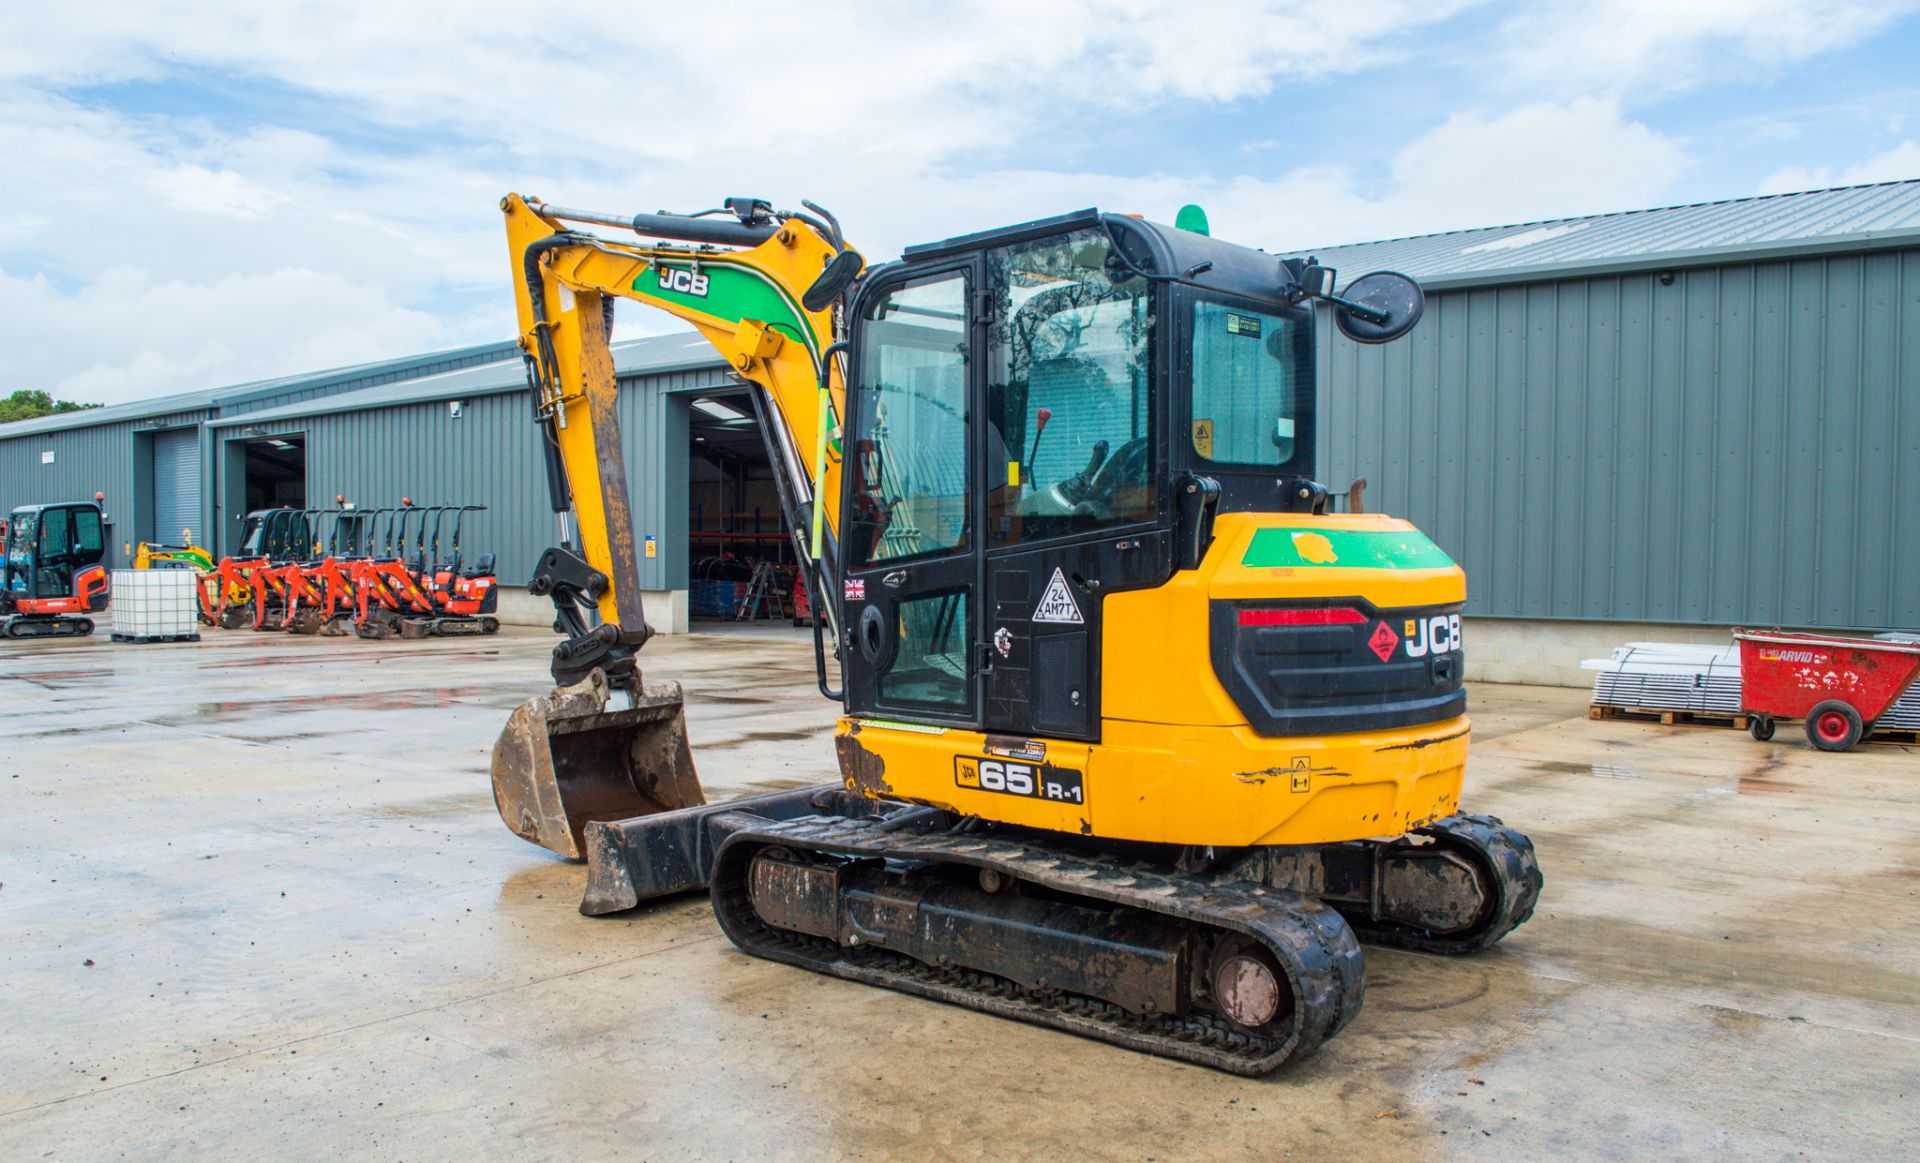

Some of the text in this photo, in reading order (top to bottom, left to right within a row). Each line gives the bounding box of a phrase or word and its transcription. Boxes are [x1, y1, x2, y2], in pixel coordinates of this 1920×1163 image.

[659, 268, 709, 296] JCB
[1051, 588, 1065, 602] 24
[1044, 602, 1072, 616] AM7T
[1404, 614, 1461, 657] JCB
[1779, 650, 1813, 664] ARVID
[979, 760, 1033, 796] 65
[1046, 781, 1082, 802] R-1
